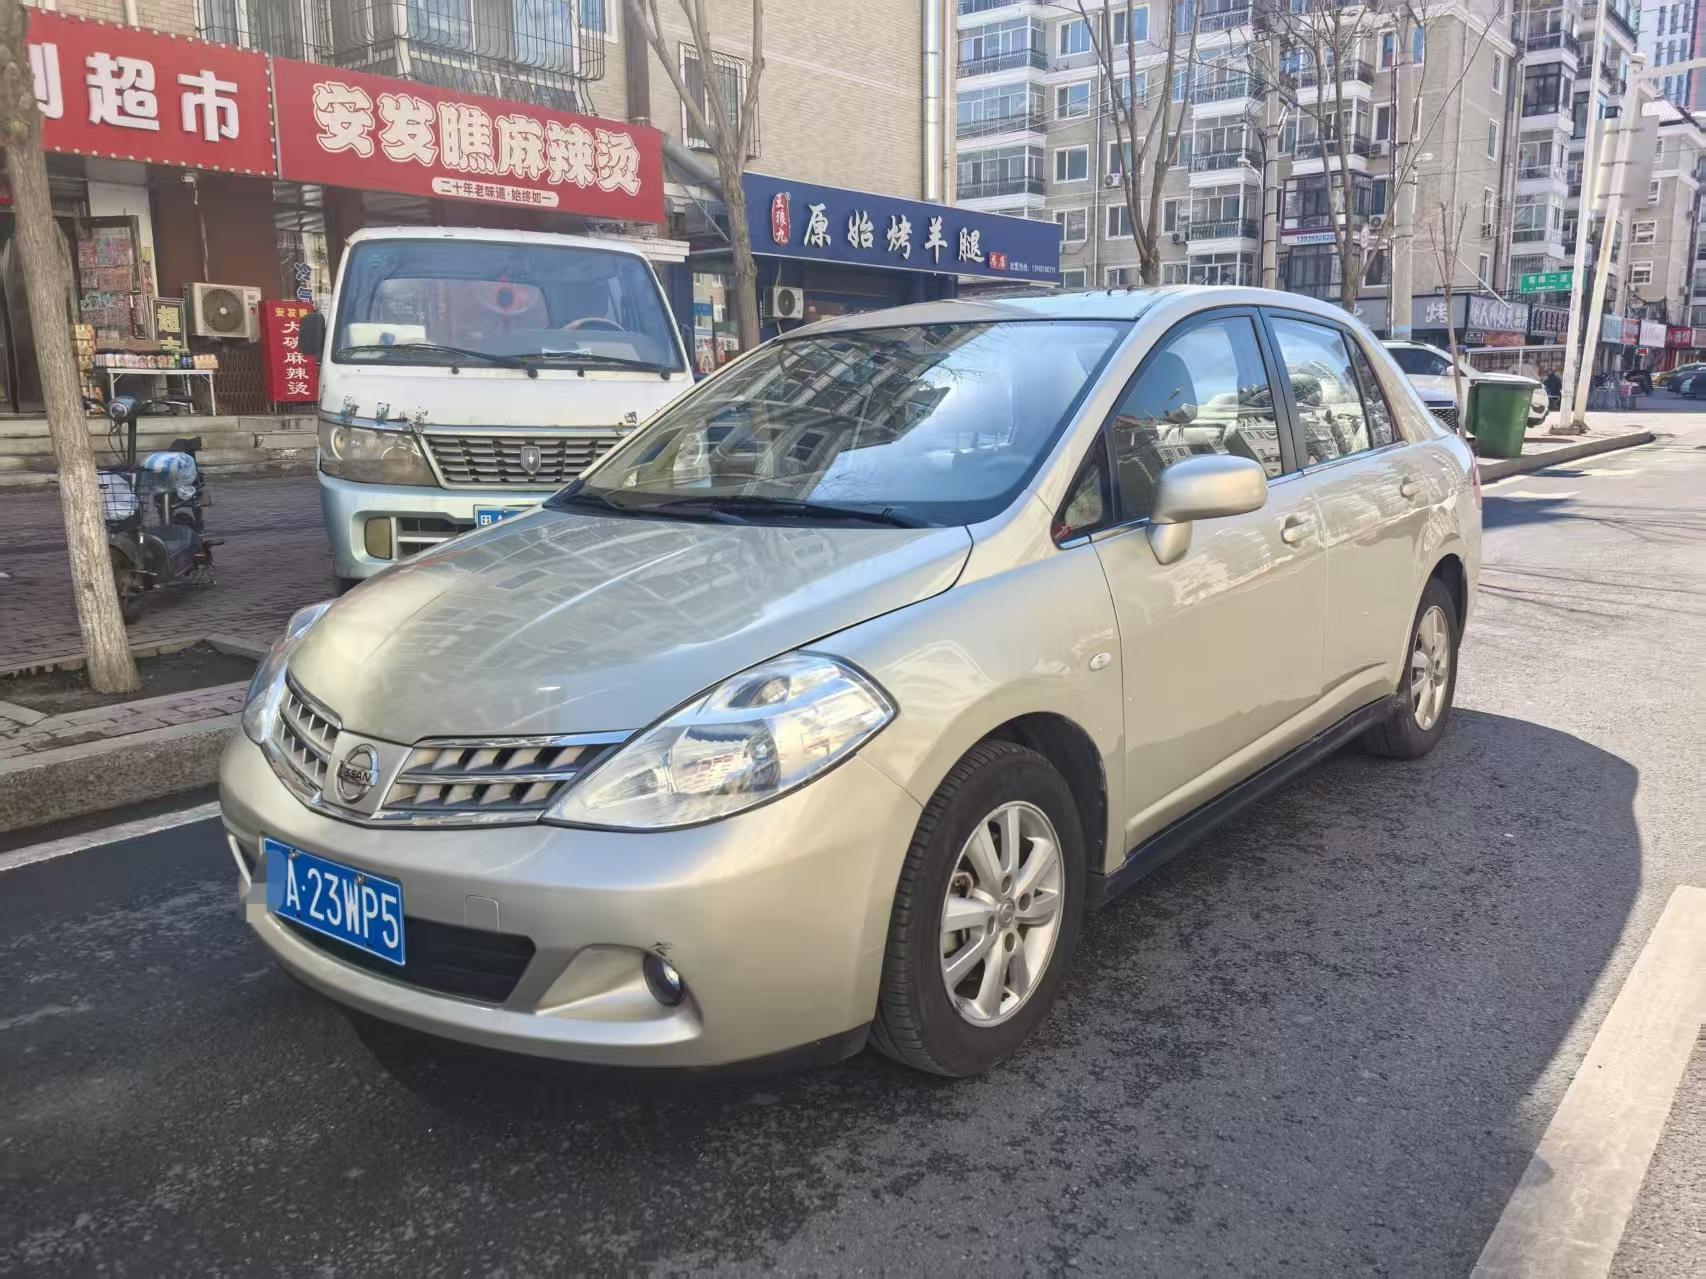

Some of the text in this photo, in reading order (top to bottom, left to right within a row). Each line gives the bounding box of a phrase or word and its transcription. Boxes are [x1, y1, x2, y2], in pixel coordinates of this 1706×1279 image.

[313, 82, 641, 196] 安发瞧麻辣烫
[803, 202, 985, 263] 原始烤羊腿
